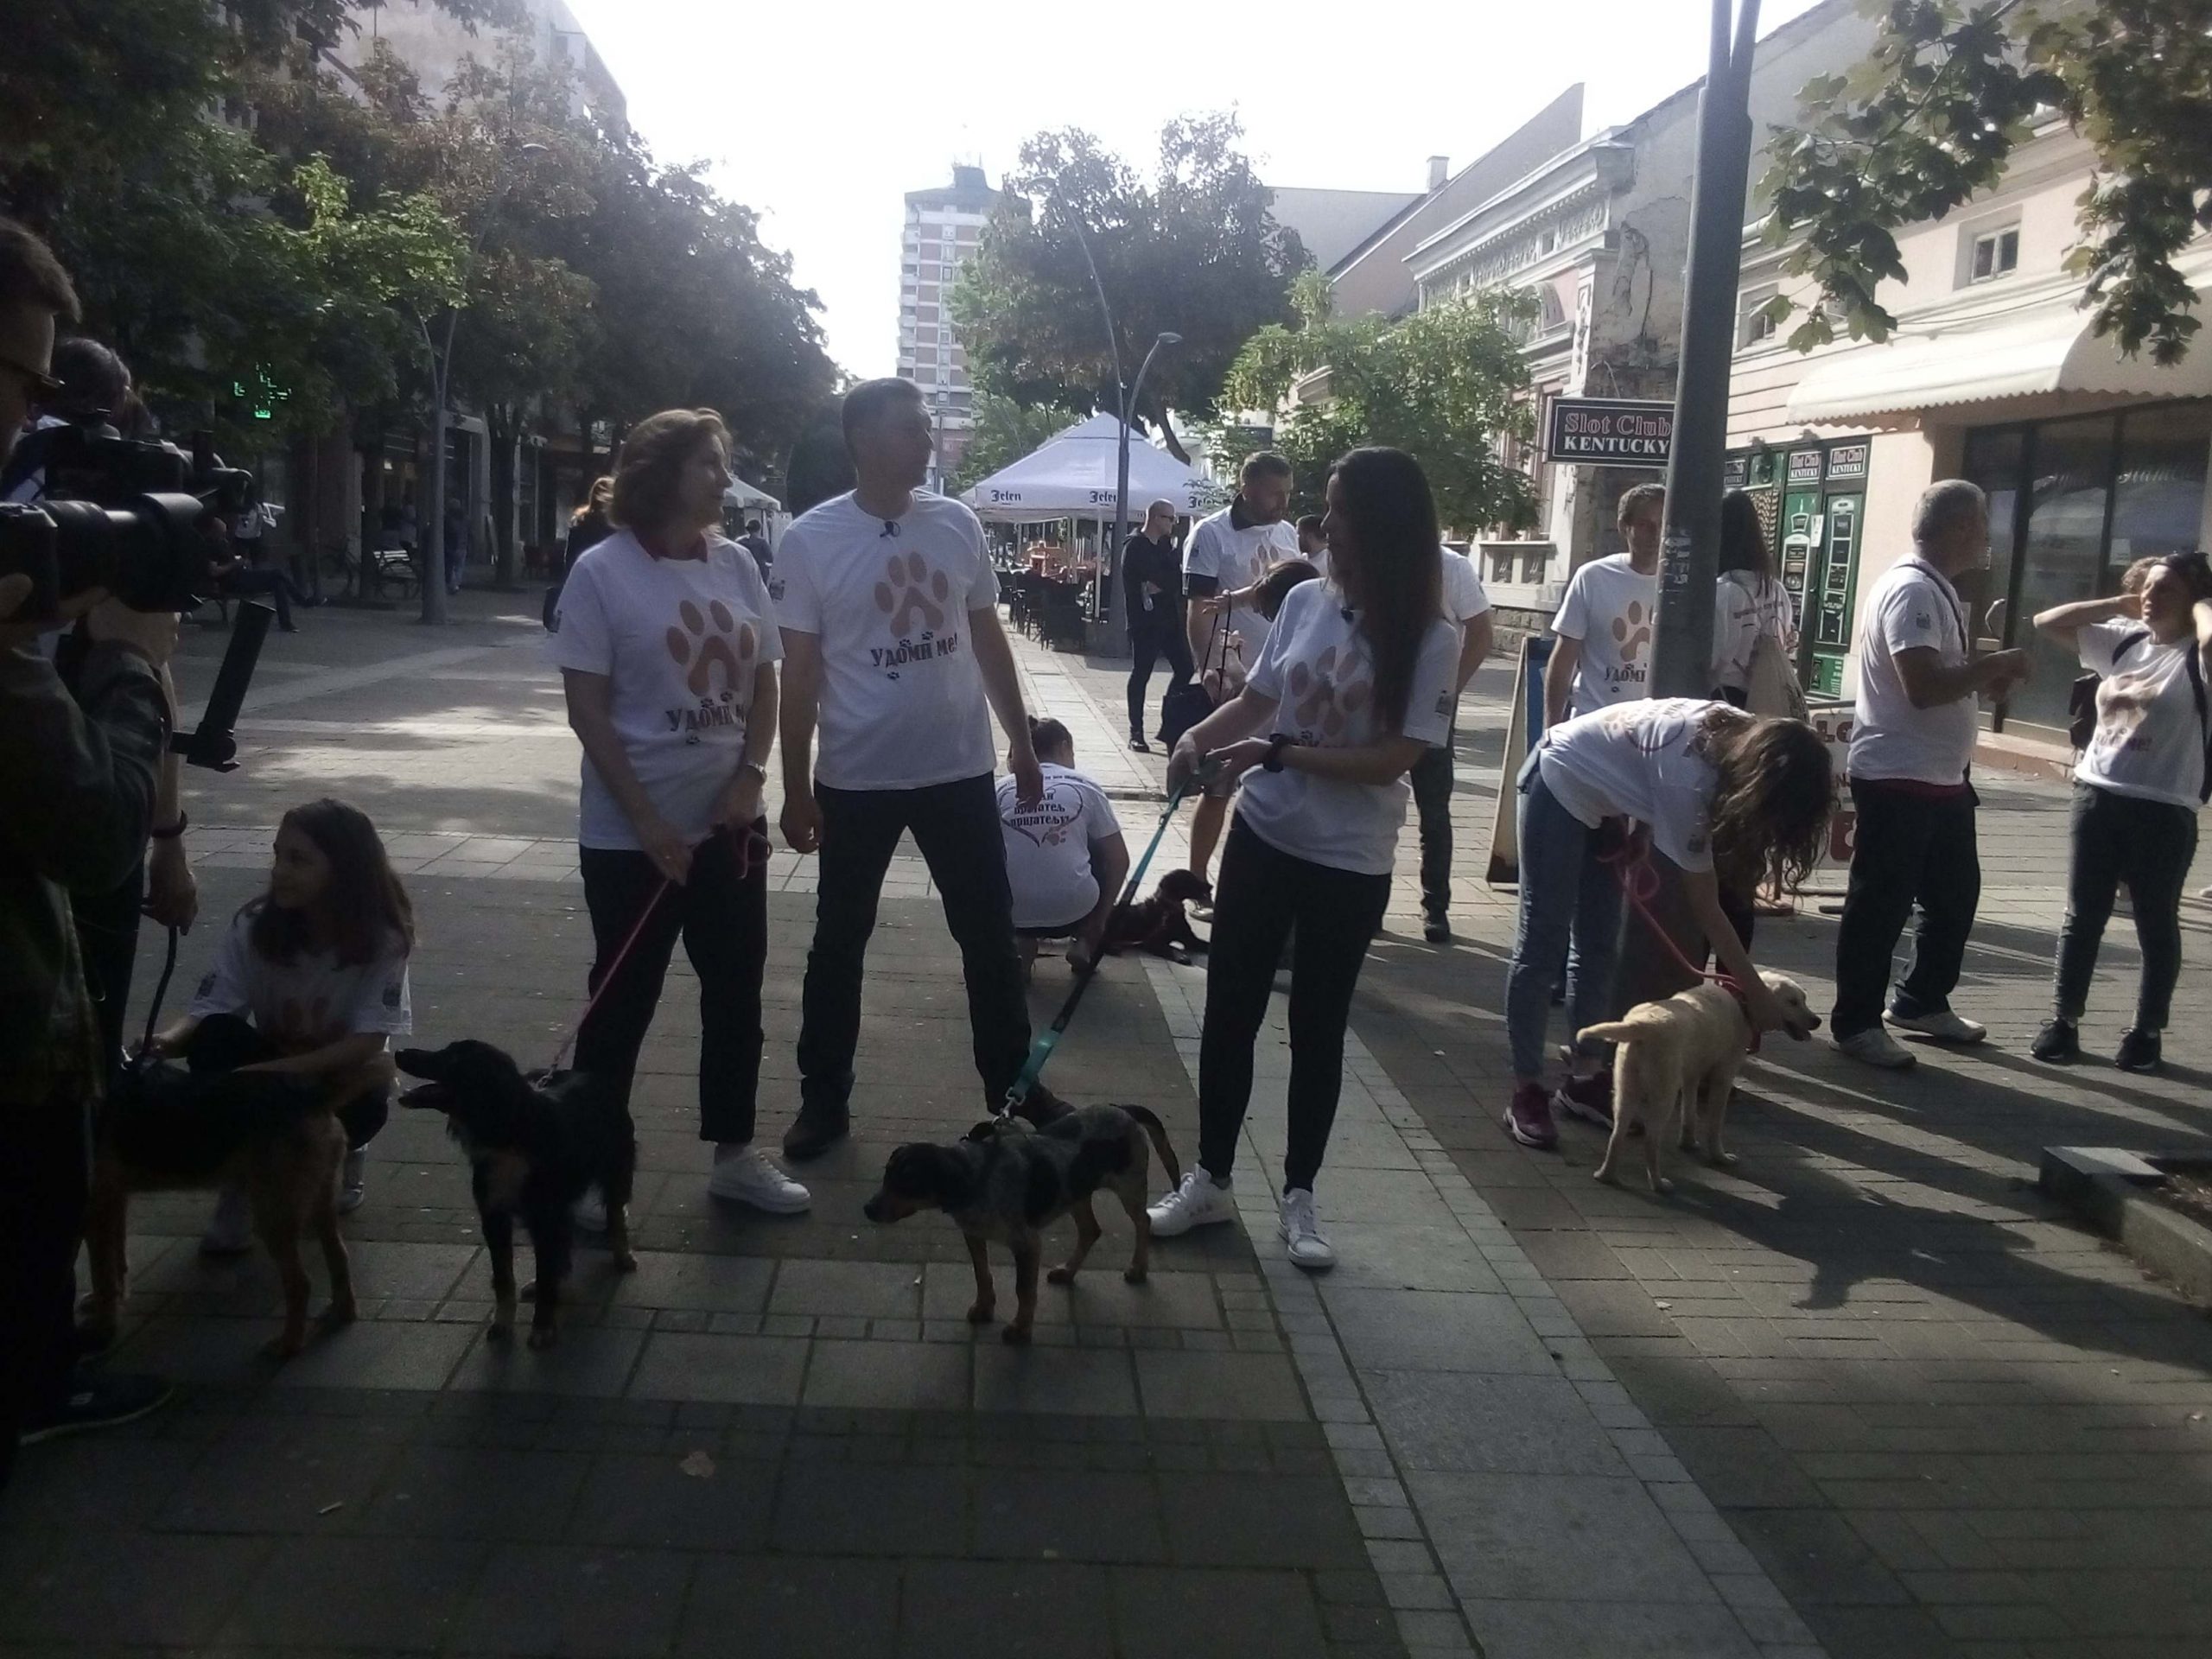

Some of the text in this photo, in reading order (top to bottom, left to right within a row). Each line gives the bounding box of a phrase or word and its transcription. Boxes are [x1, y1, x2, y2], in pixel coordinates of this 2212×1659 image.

[1565, 413, 1672, 436] Slot Club
[1565, 435, 1670, 454] KENTUCKY
[990, 489, 1021, 502] Jelen
